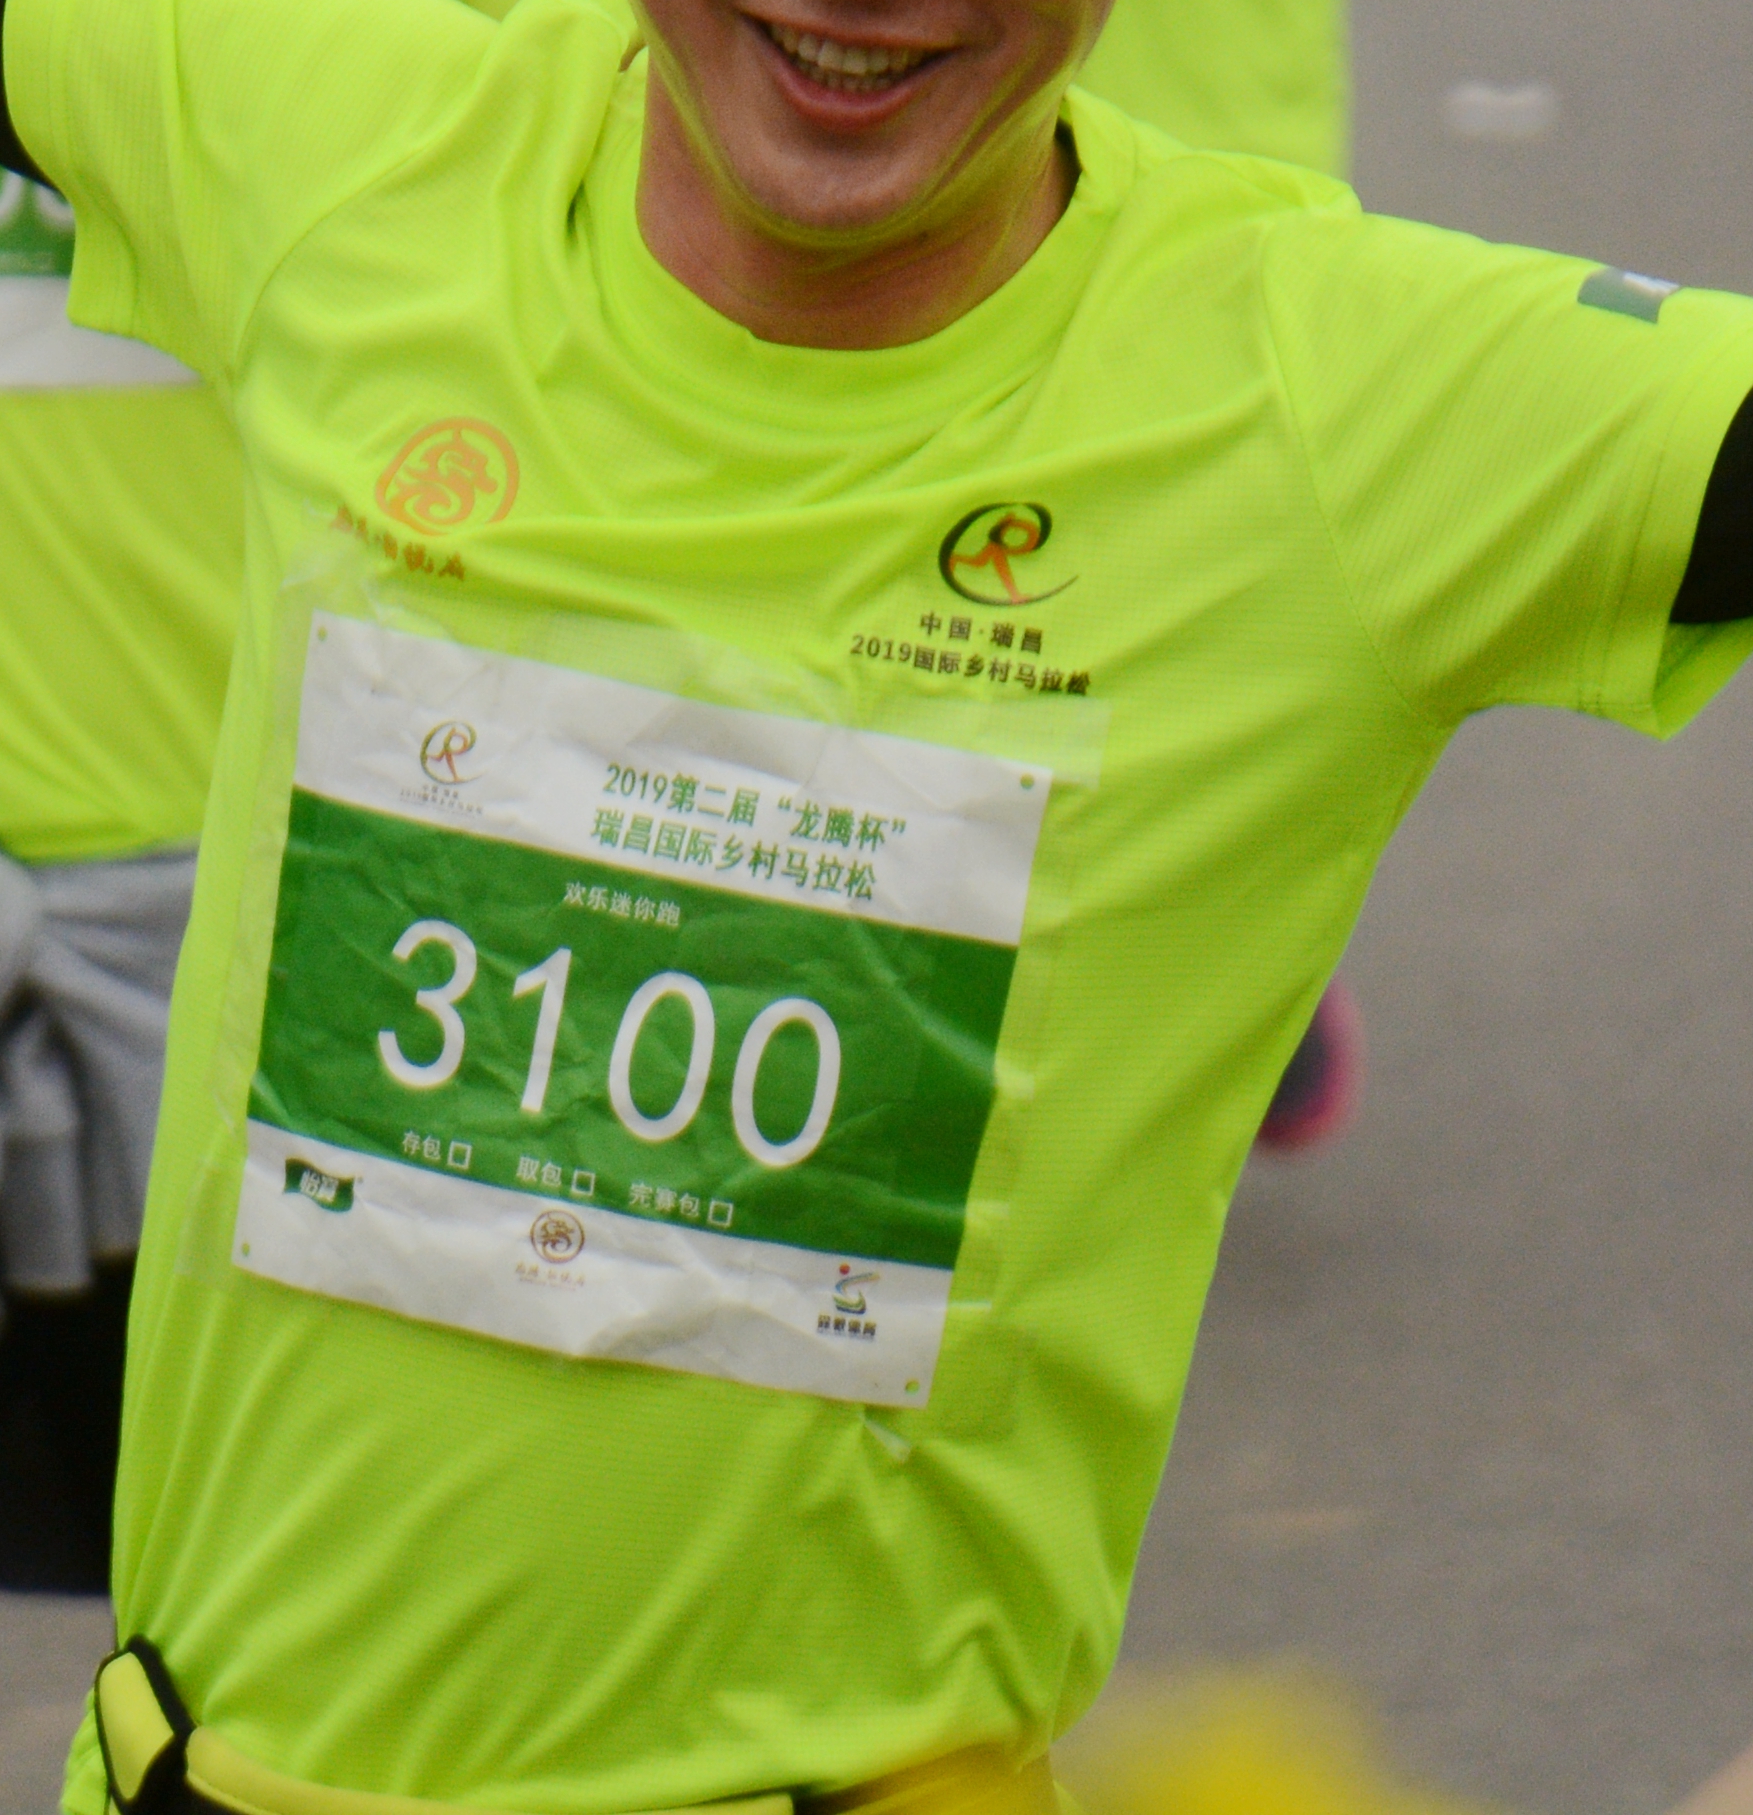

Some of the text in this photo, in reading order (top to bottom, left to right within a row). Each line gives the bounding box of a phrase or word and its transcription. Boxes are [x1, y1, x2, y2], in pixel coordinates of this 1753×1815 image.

[849, 634, 1091, 695] 2019国际乡村马拉松
[591, 807, 877, 901] 瑞昌国际乡村马拉松
[563, 881, 681, 928] 欢乐迷你跑
[377, 918, 843, 1168] 3100
